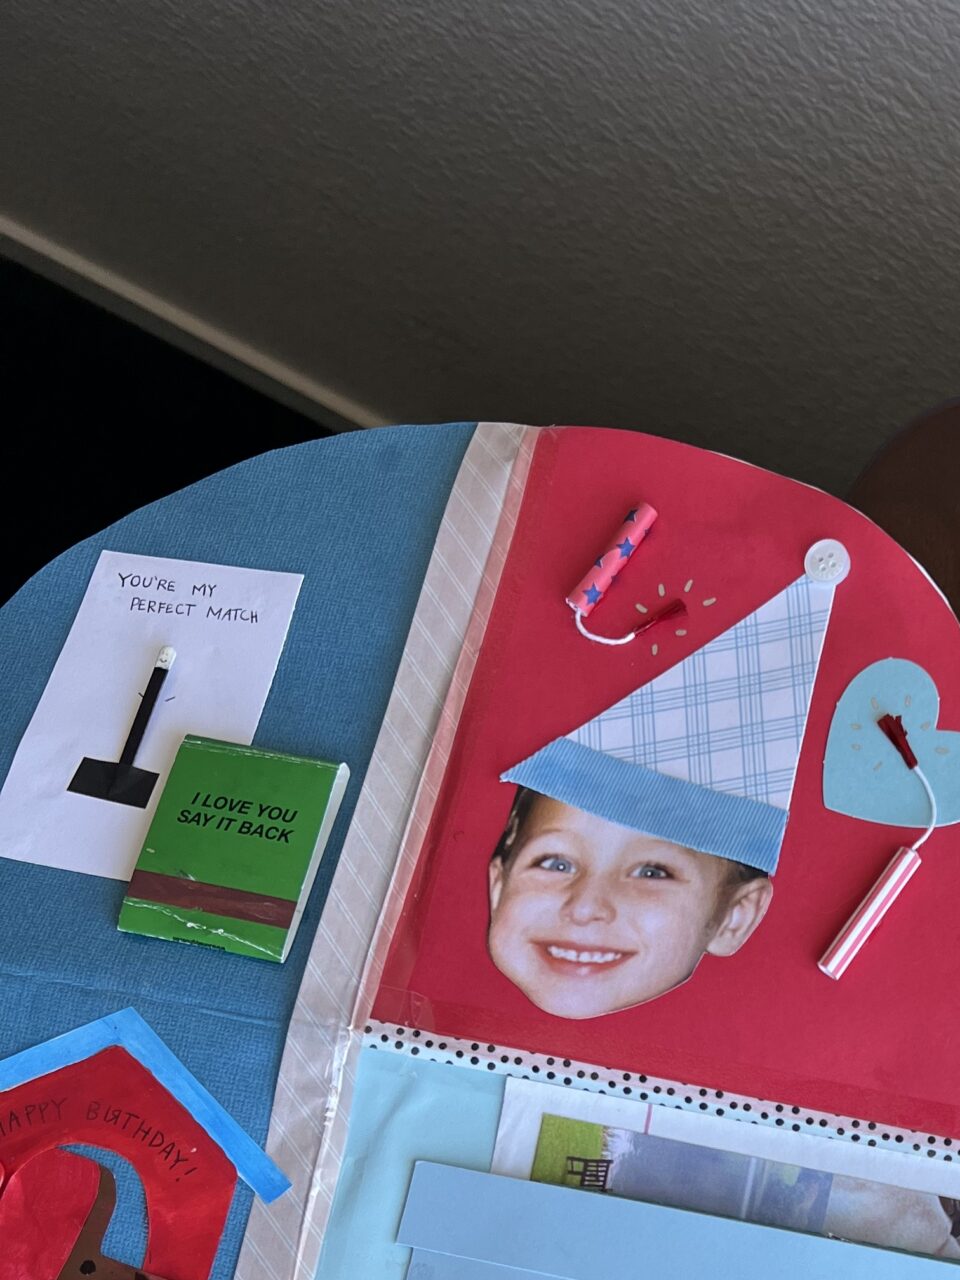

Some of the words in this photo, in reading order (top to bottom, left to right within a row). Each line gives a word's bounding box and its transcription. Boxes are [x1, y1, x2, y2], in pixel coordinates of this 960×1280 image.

[192, 583, 217, 598] MY
[129, 596, 197, 617] PERFECT
[206, 606, 259, 624] MATCH
[191, 792, 200, 805] I
[201, 795, 250, 816] LOVE
[258, 802, 299, 824] YOU
[176, 809, 211, 828] SAY
[215, 816, 234, 831] IT
[237, 821, 295, 844] BACK
